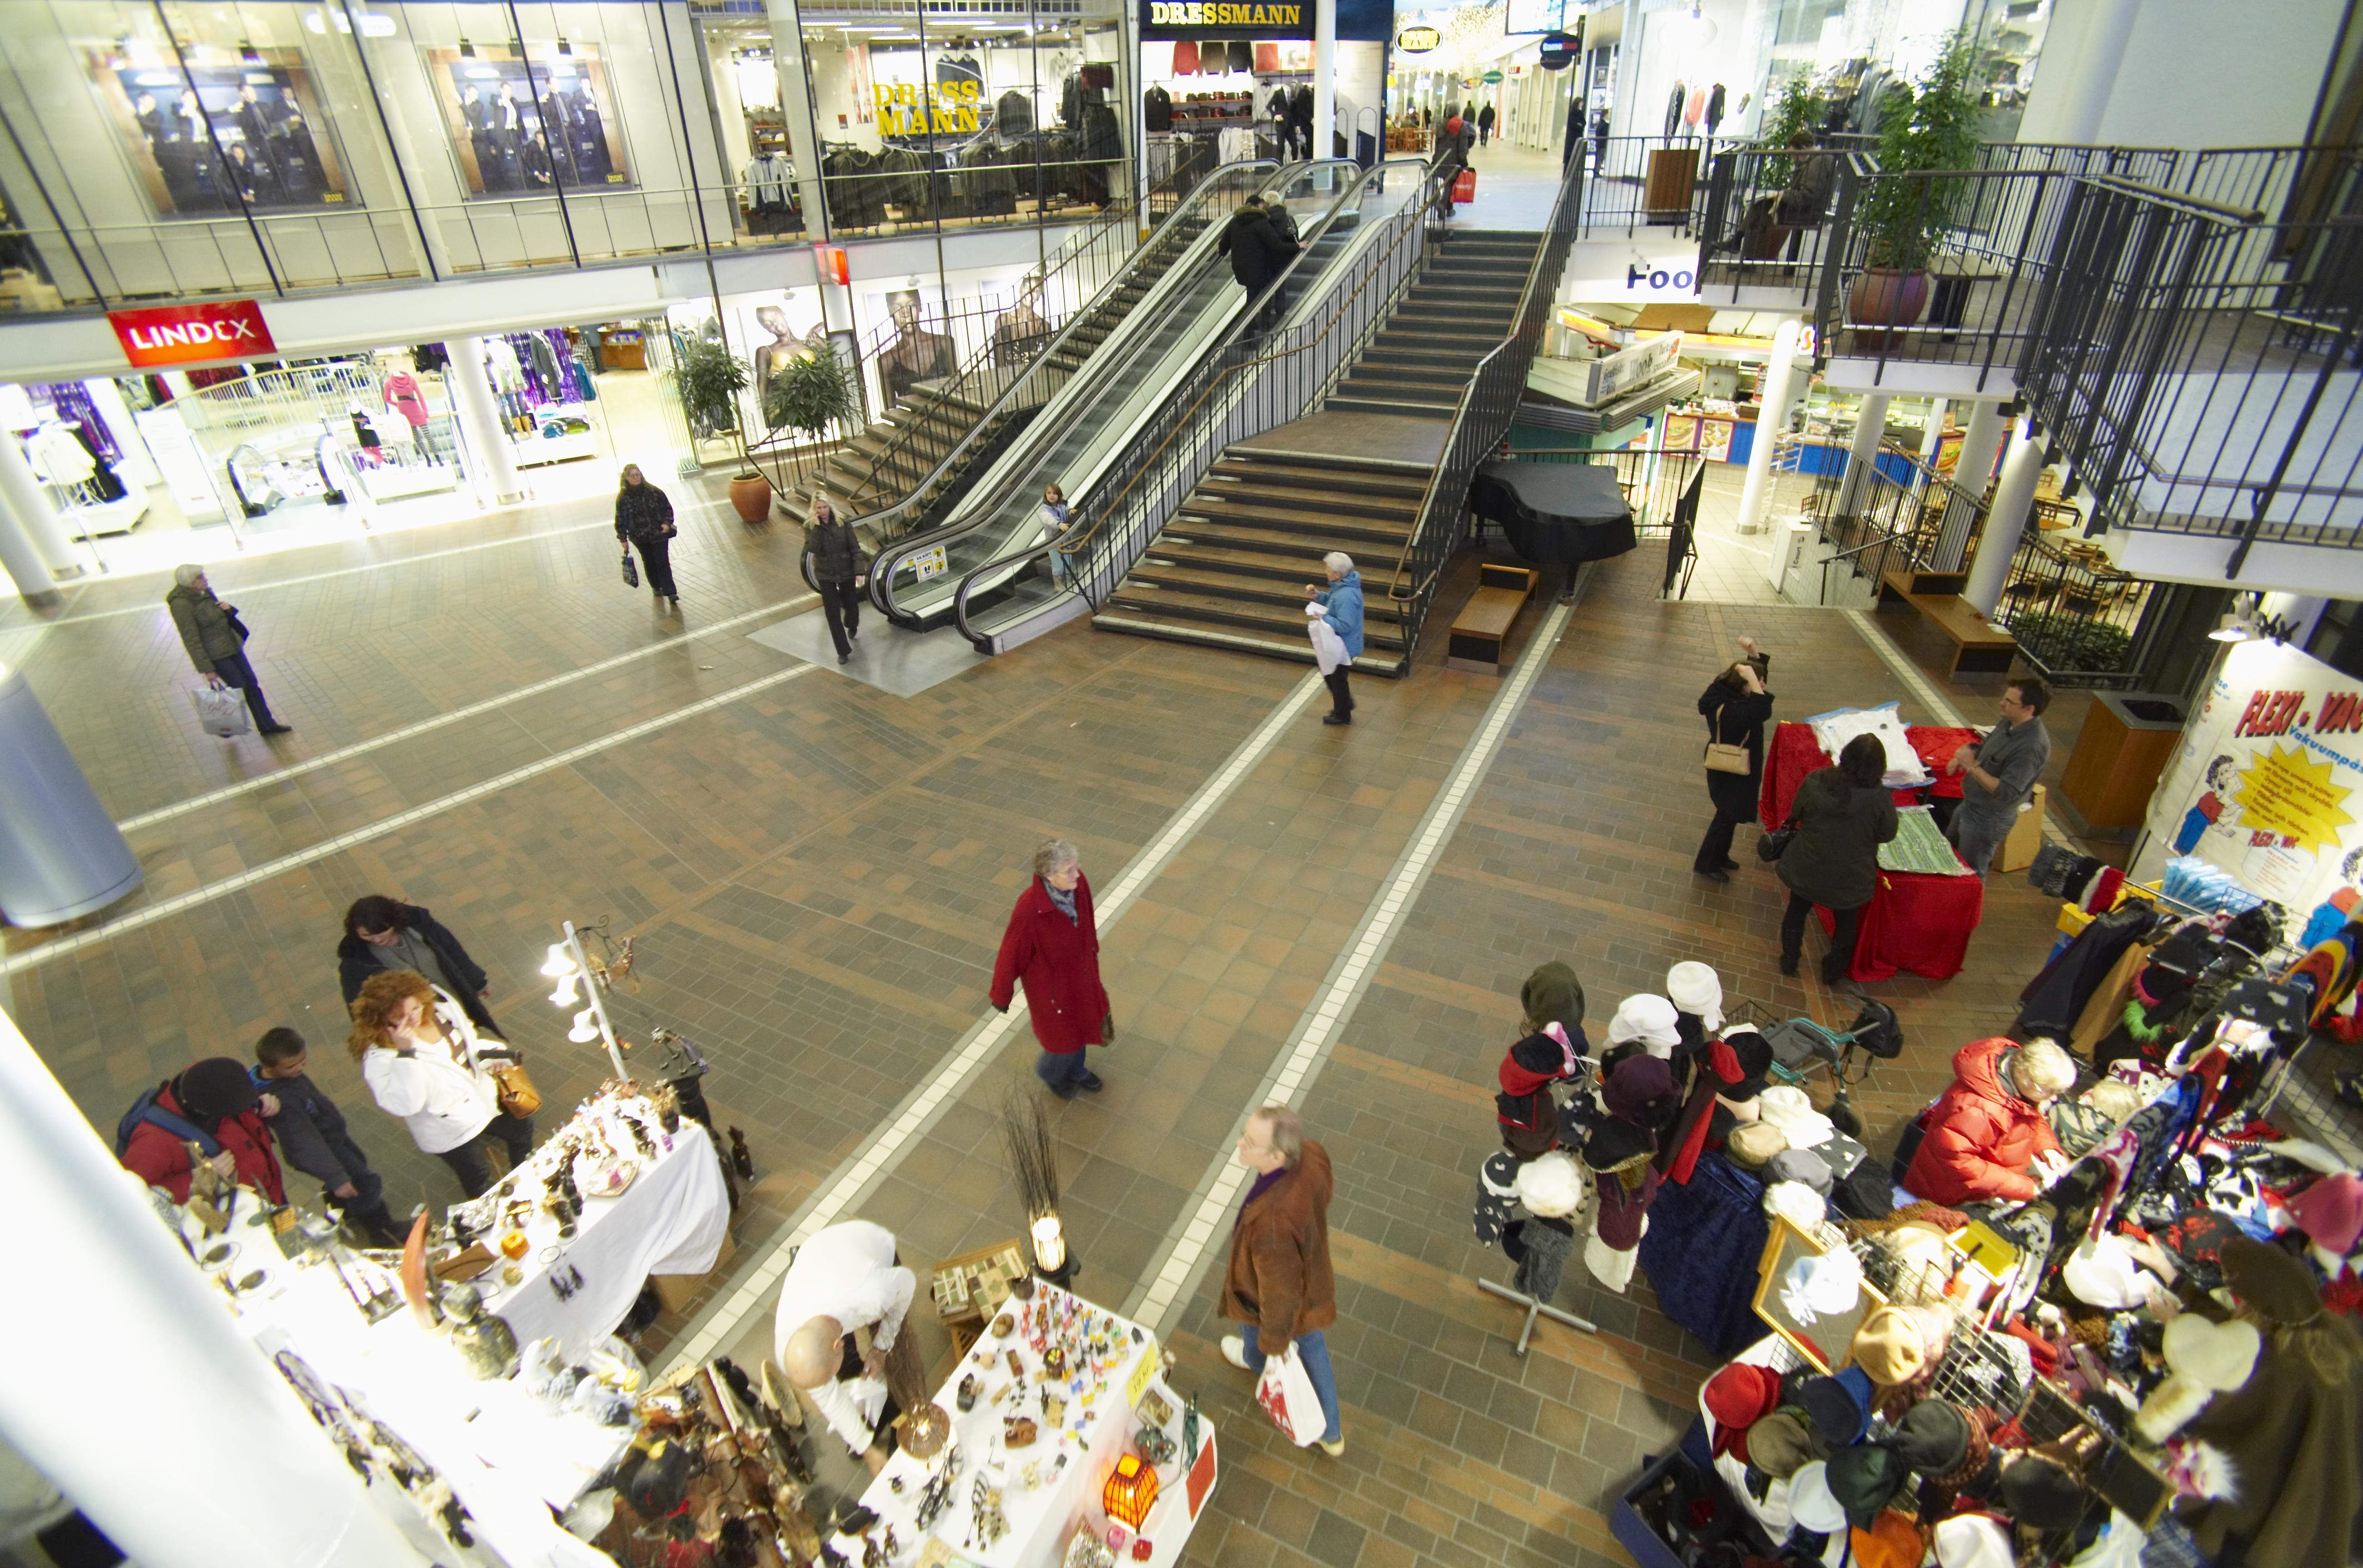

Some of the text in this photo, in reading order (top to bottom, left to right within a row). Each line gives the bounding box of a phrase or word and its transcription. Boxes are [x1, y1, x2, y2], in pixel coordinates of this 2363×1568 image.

[1151, 2, 1300, 25] DRESSMANN
[1543, 41, 1578, 52] GameStop
[872, 80, 979, 107] DRESS
[875, 107, 979, 135] MANN
[1627, 264, 1695, 289] Foo
[128, 319, 256, 349] LINDEX
[1793, 547, 1802, 564] Court
[2234, 690, 2305, 738] FLEXI
